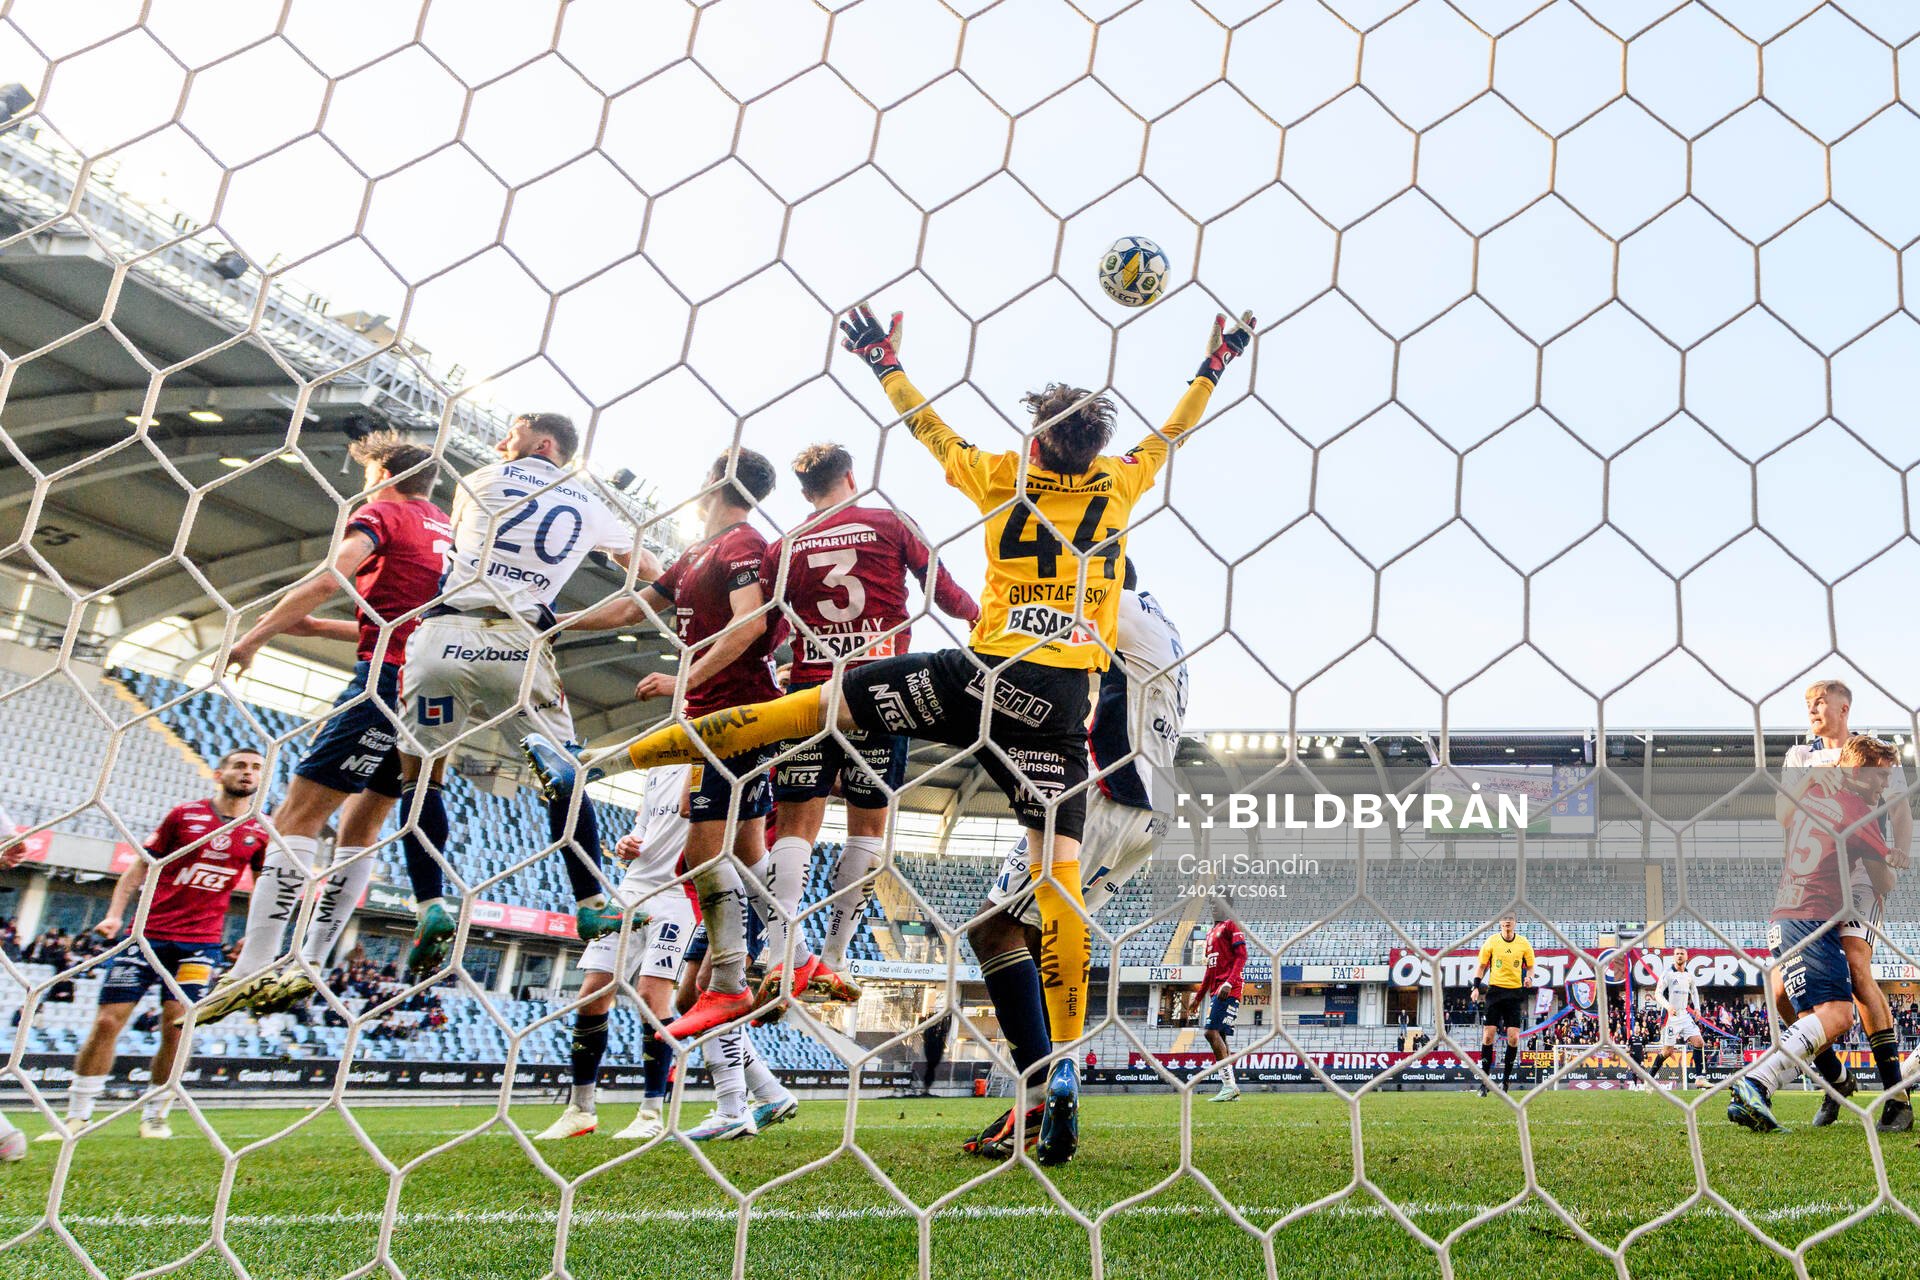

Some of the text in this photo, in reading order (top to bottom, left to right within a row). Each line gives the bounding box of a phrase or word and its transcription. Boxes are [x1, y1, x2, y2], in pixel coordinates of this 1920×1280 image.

[1104, 281, 1139, 304] SELECT
[493, 488, 583, 565] 20
[1000, 493, 1121, 580] 44
[807, 548, 866, 623] 3
[1008, 607, 1072, 640] BESAB
[442, 645, 530, 662] Flexbuss
[806, 636, 866, 661] BESAB
[905, 672, 936, 726] Månsson
[777, 765, 823, 786] NTEX
[172, 862, 238, 892] NTEX
[268, 867, 304, 920] MIKE
[315, 874, 348, 922] MIKE
[831, 910, 843, 936] umbro
[1041, 919, 1063, 989] MIKE
[1149, 967, 1182, 980] FAT21
[1332, 967, 1366, 980] FAT21
[1882, 965, 1916, 978] FAT21
[1068, 987, 1077, 1017] umbro
[1243, 995, 1272, 1005] FAT21
[1138, 1073, 1159, 1081] Ullevi
[1258, 1073, 1302, 1081] Gamla Ullevi
[1331, 1073, 1374, 1081] Gamla Ullevi
[1402, 1073, 1445, 1081] Gamla Ullevi
[1856, 1072, 1876, 1080] Ullevi
